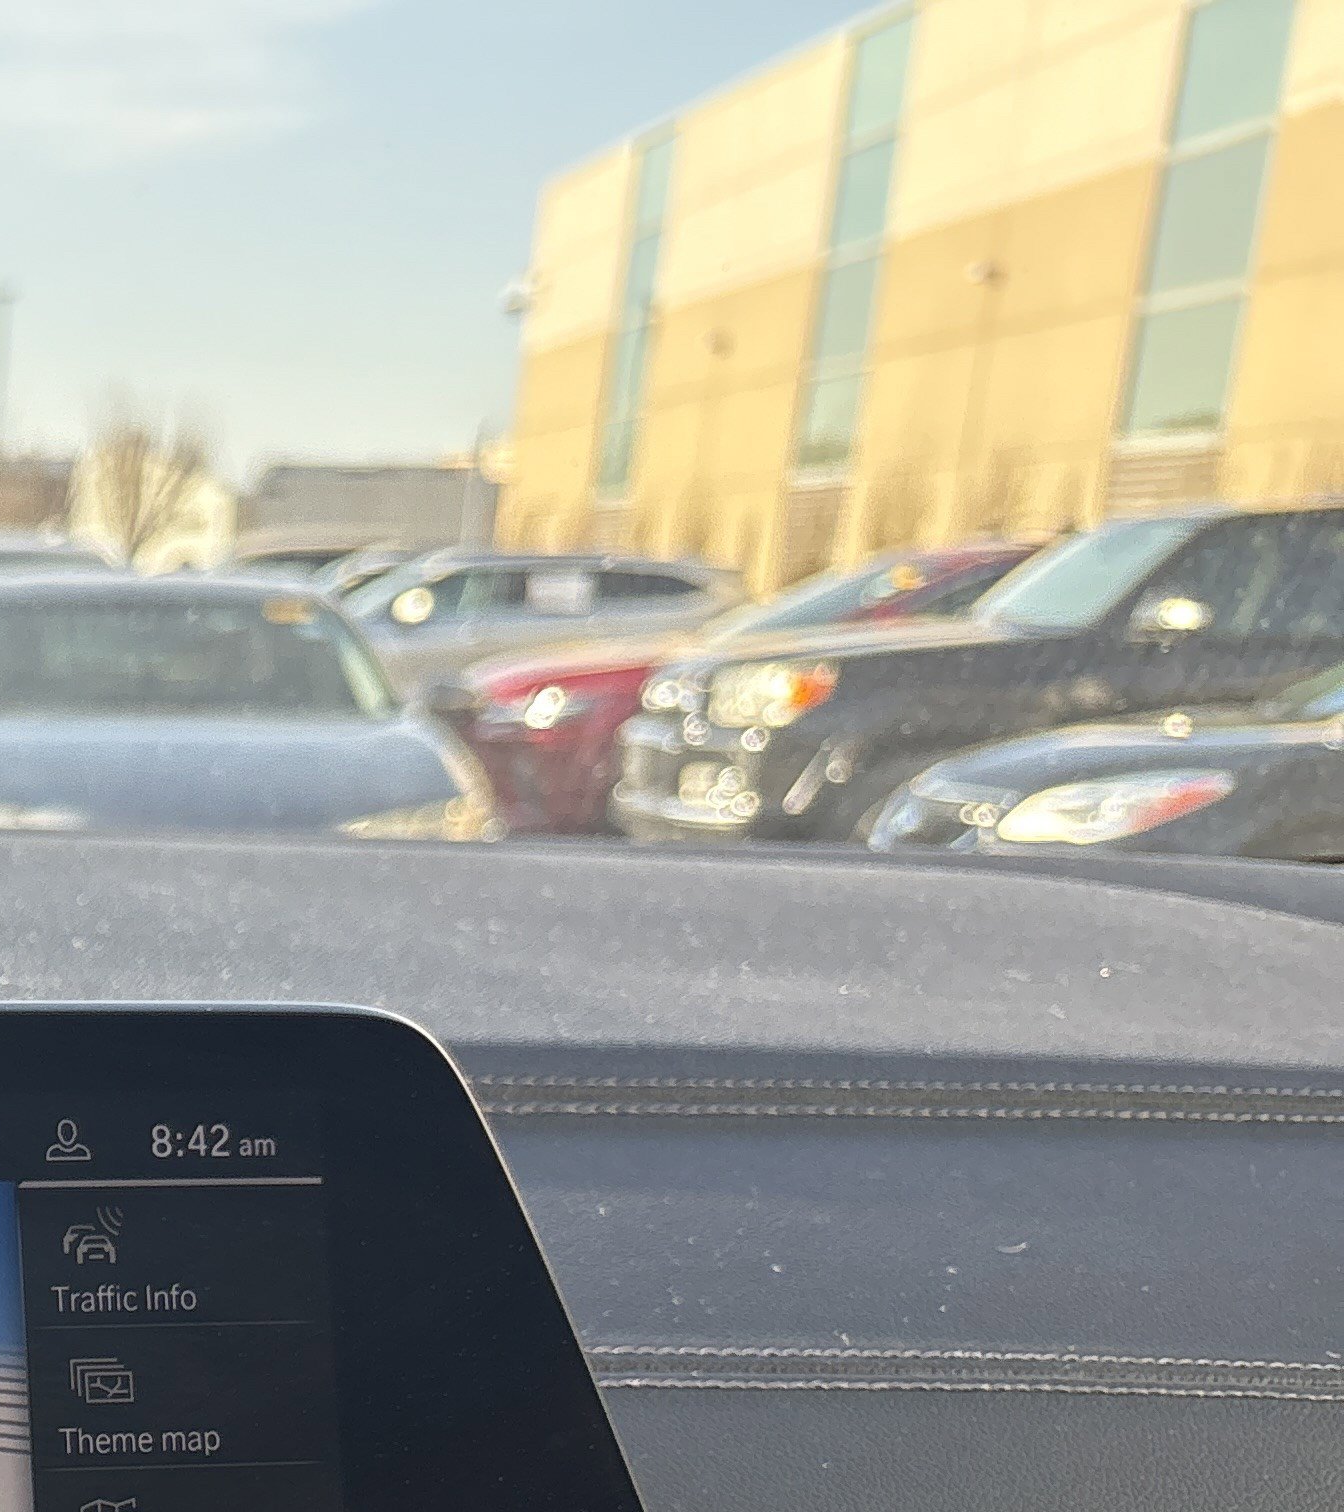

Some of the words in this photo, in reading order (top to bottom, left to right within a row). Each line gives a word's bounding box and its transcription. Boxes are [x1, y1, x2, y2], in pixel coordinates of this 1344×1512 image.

[150, 1125, 232, 1159] 8:42
[238, 1137, 277, 1158] am
[50, 1284, 138, 1314] Traffic
[144, 1284, 198, 1312] Info
[57, 1426, 155, 1455] Theme
[160, 1429, 222, 1456] map
